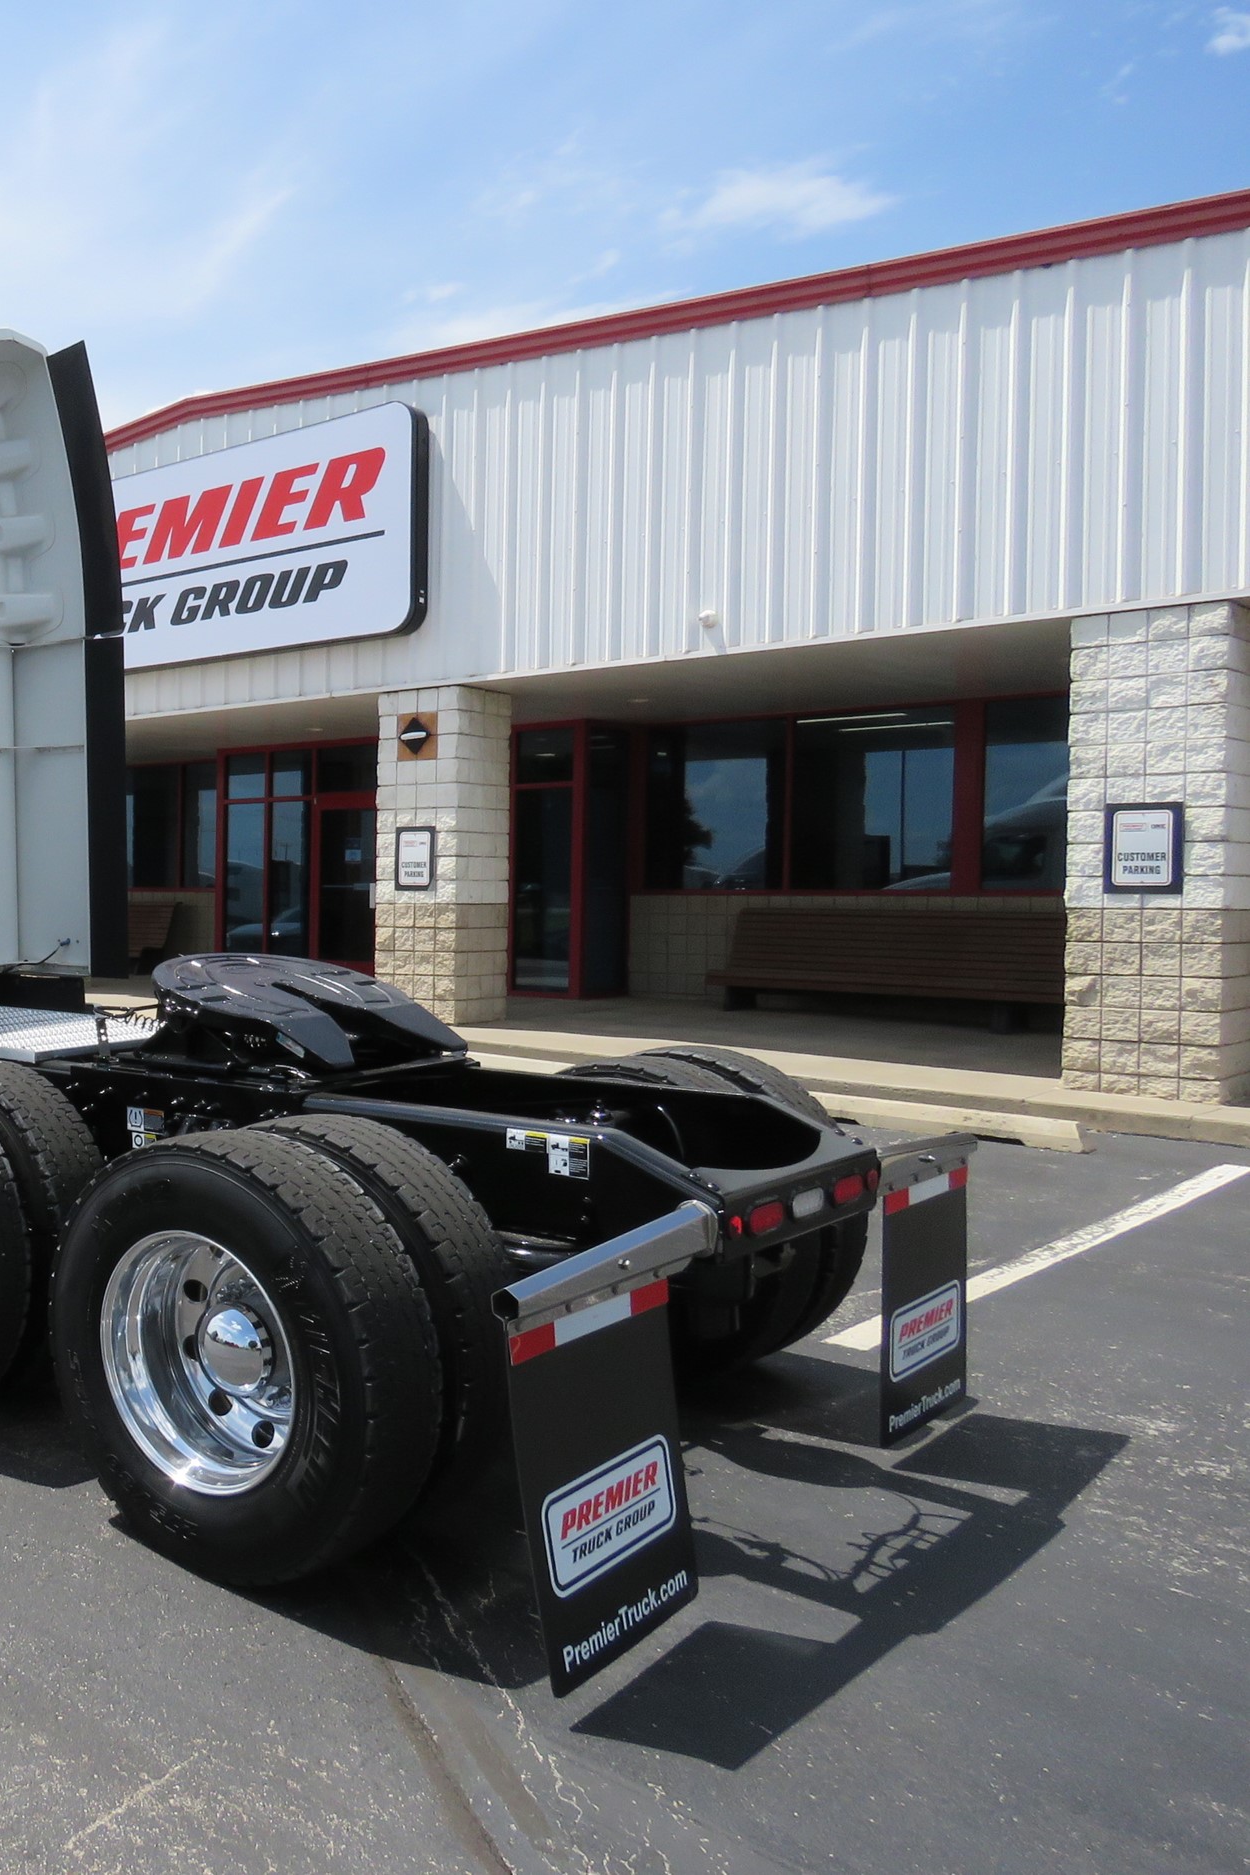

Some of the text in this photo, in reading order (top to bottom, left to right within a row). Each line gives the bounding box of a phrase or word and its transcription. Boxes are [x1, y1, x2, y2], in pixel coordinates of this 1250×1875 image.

[170, 560, 348, 626] GROUP
[1117, 852, 1166, 861] CUSTOMER
[1122, 865, 1161, 875] PARKING
[899, 1298, 954, 1343] PREMIER
[902, 1325, 950, 1361] TRUCK GROUP
[889, 1378, 961, 1433] PremierTruck.com
[560, 1460, 659, 1541] PREMIER
[572, 1499, 656, 1564] TRUCK GROUP
[562, 1569, 688, 1673] PremierTruck.com
